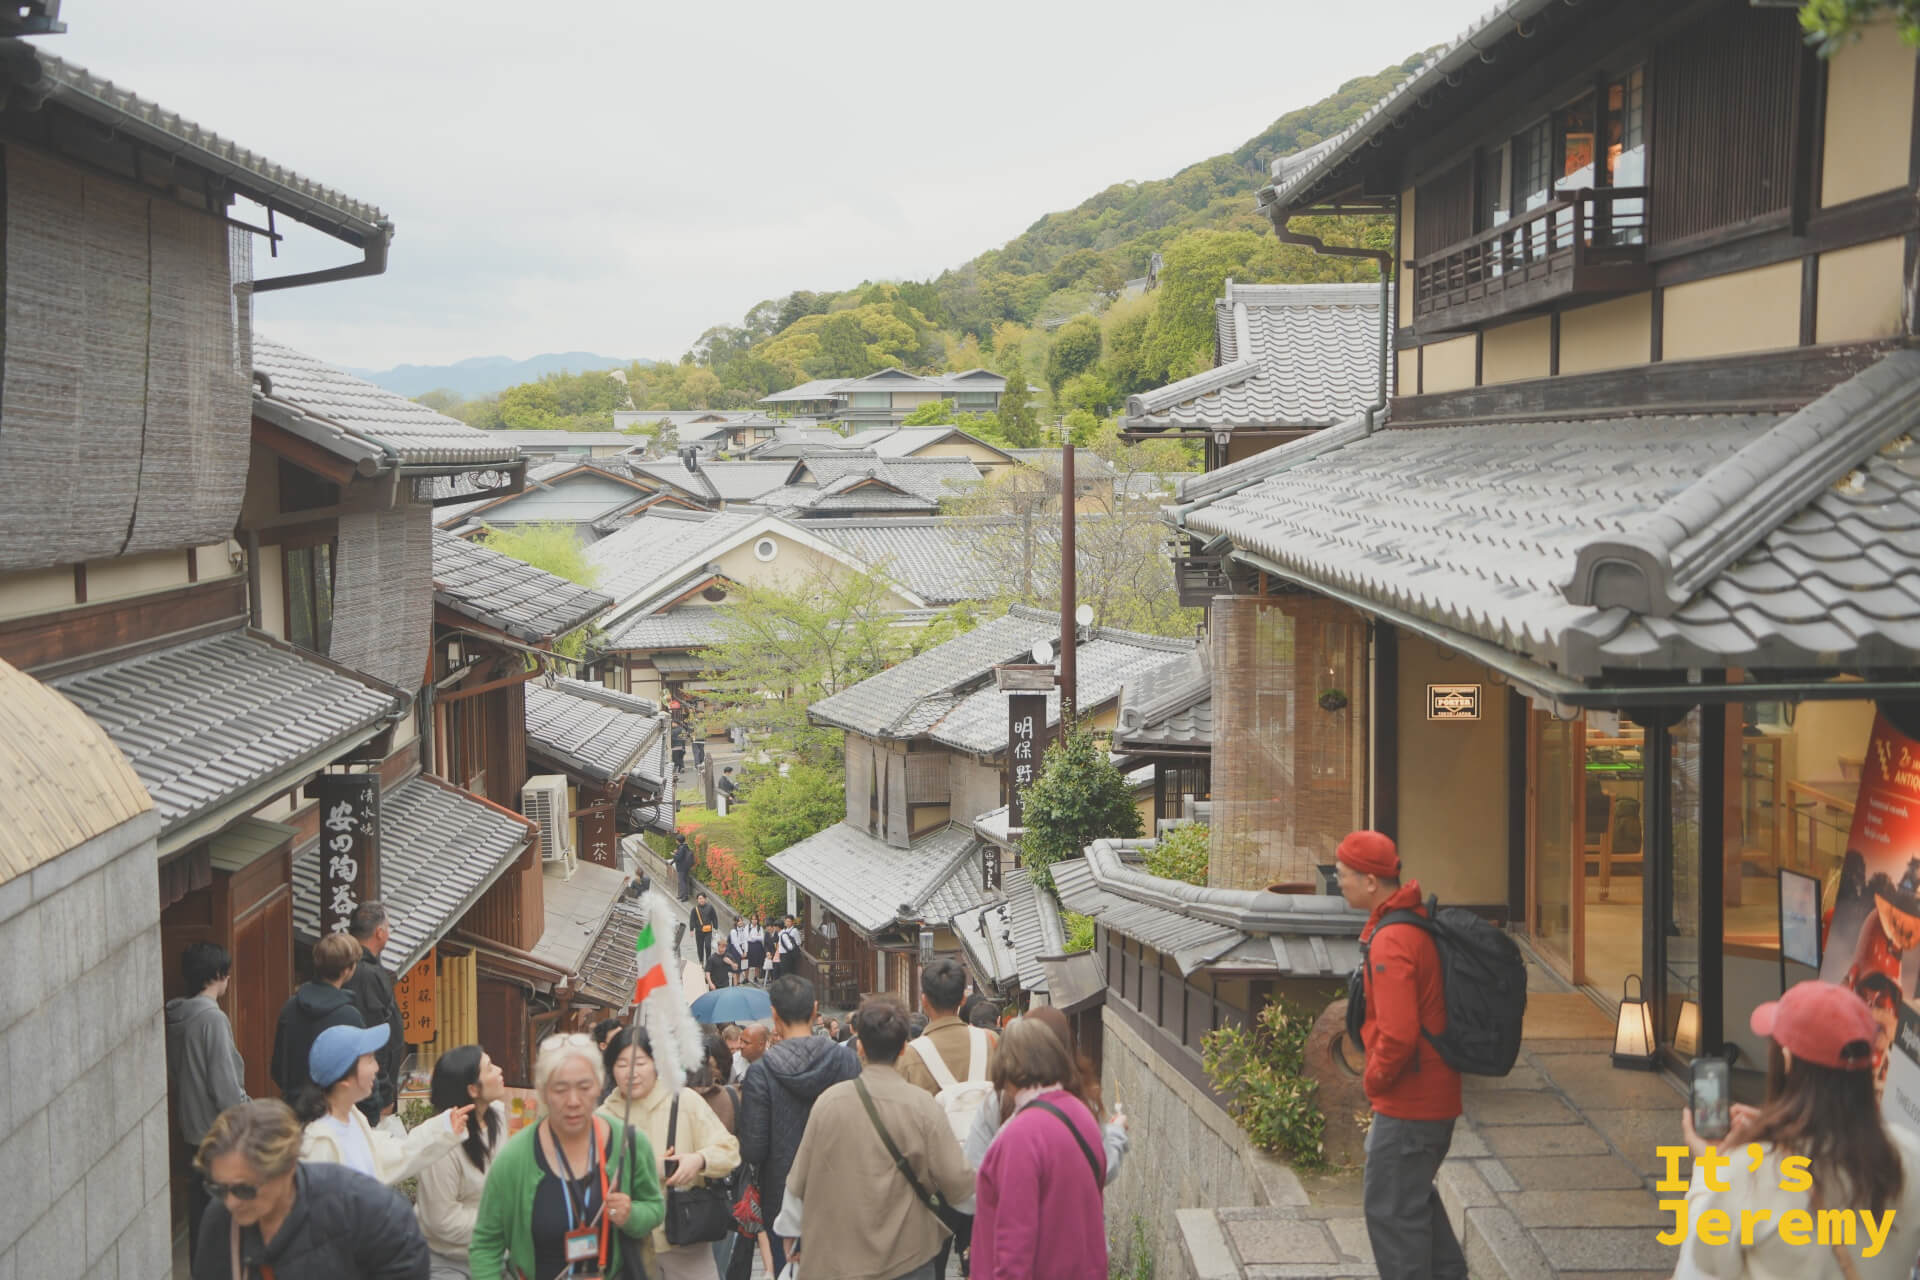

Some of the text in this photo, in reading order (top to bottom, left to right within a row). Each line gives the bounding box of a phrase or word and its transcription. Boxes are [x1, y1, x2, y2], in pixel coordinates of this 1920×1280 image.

[1894, 770, 1920, 792] ANTIQ
[360, 789, 376, 836] 清水焼
